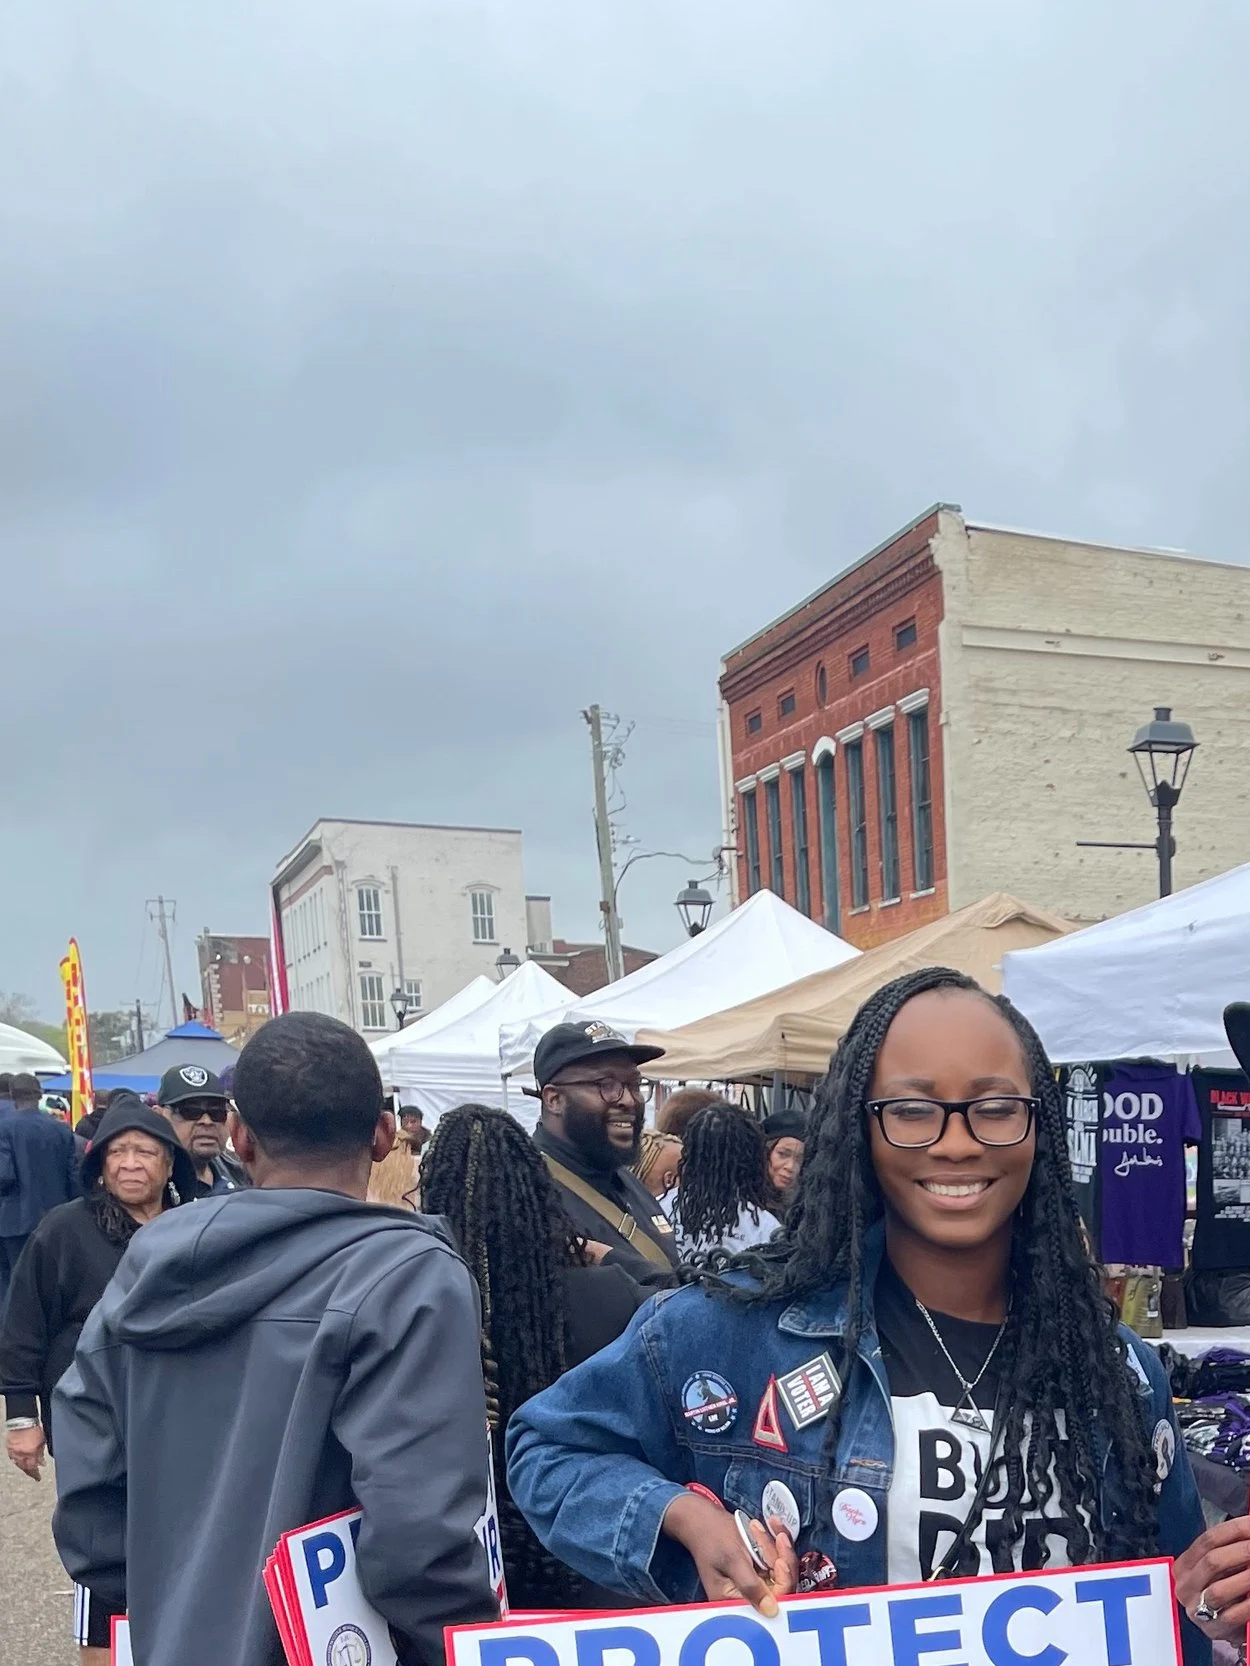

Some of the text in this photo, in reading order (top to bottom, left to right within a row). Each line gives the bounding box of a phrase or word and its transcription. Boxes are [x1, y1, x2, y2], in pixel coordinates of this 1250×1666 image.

[1103, 1091, 1164, 1120] OD
[1103, 1123, 1163, 1144] uble.
[786, 1374, 817, 1419] VOTER
